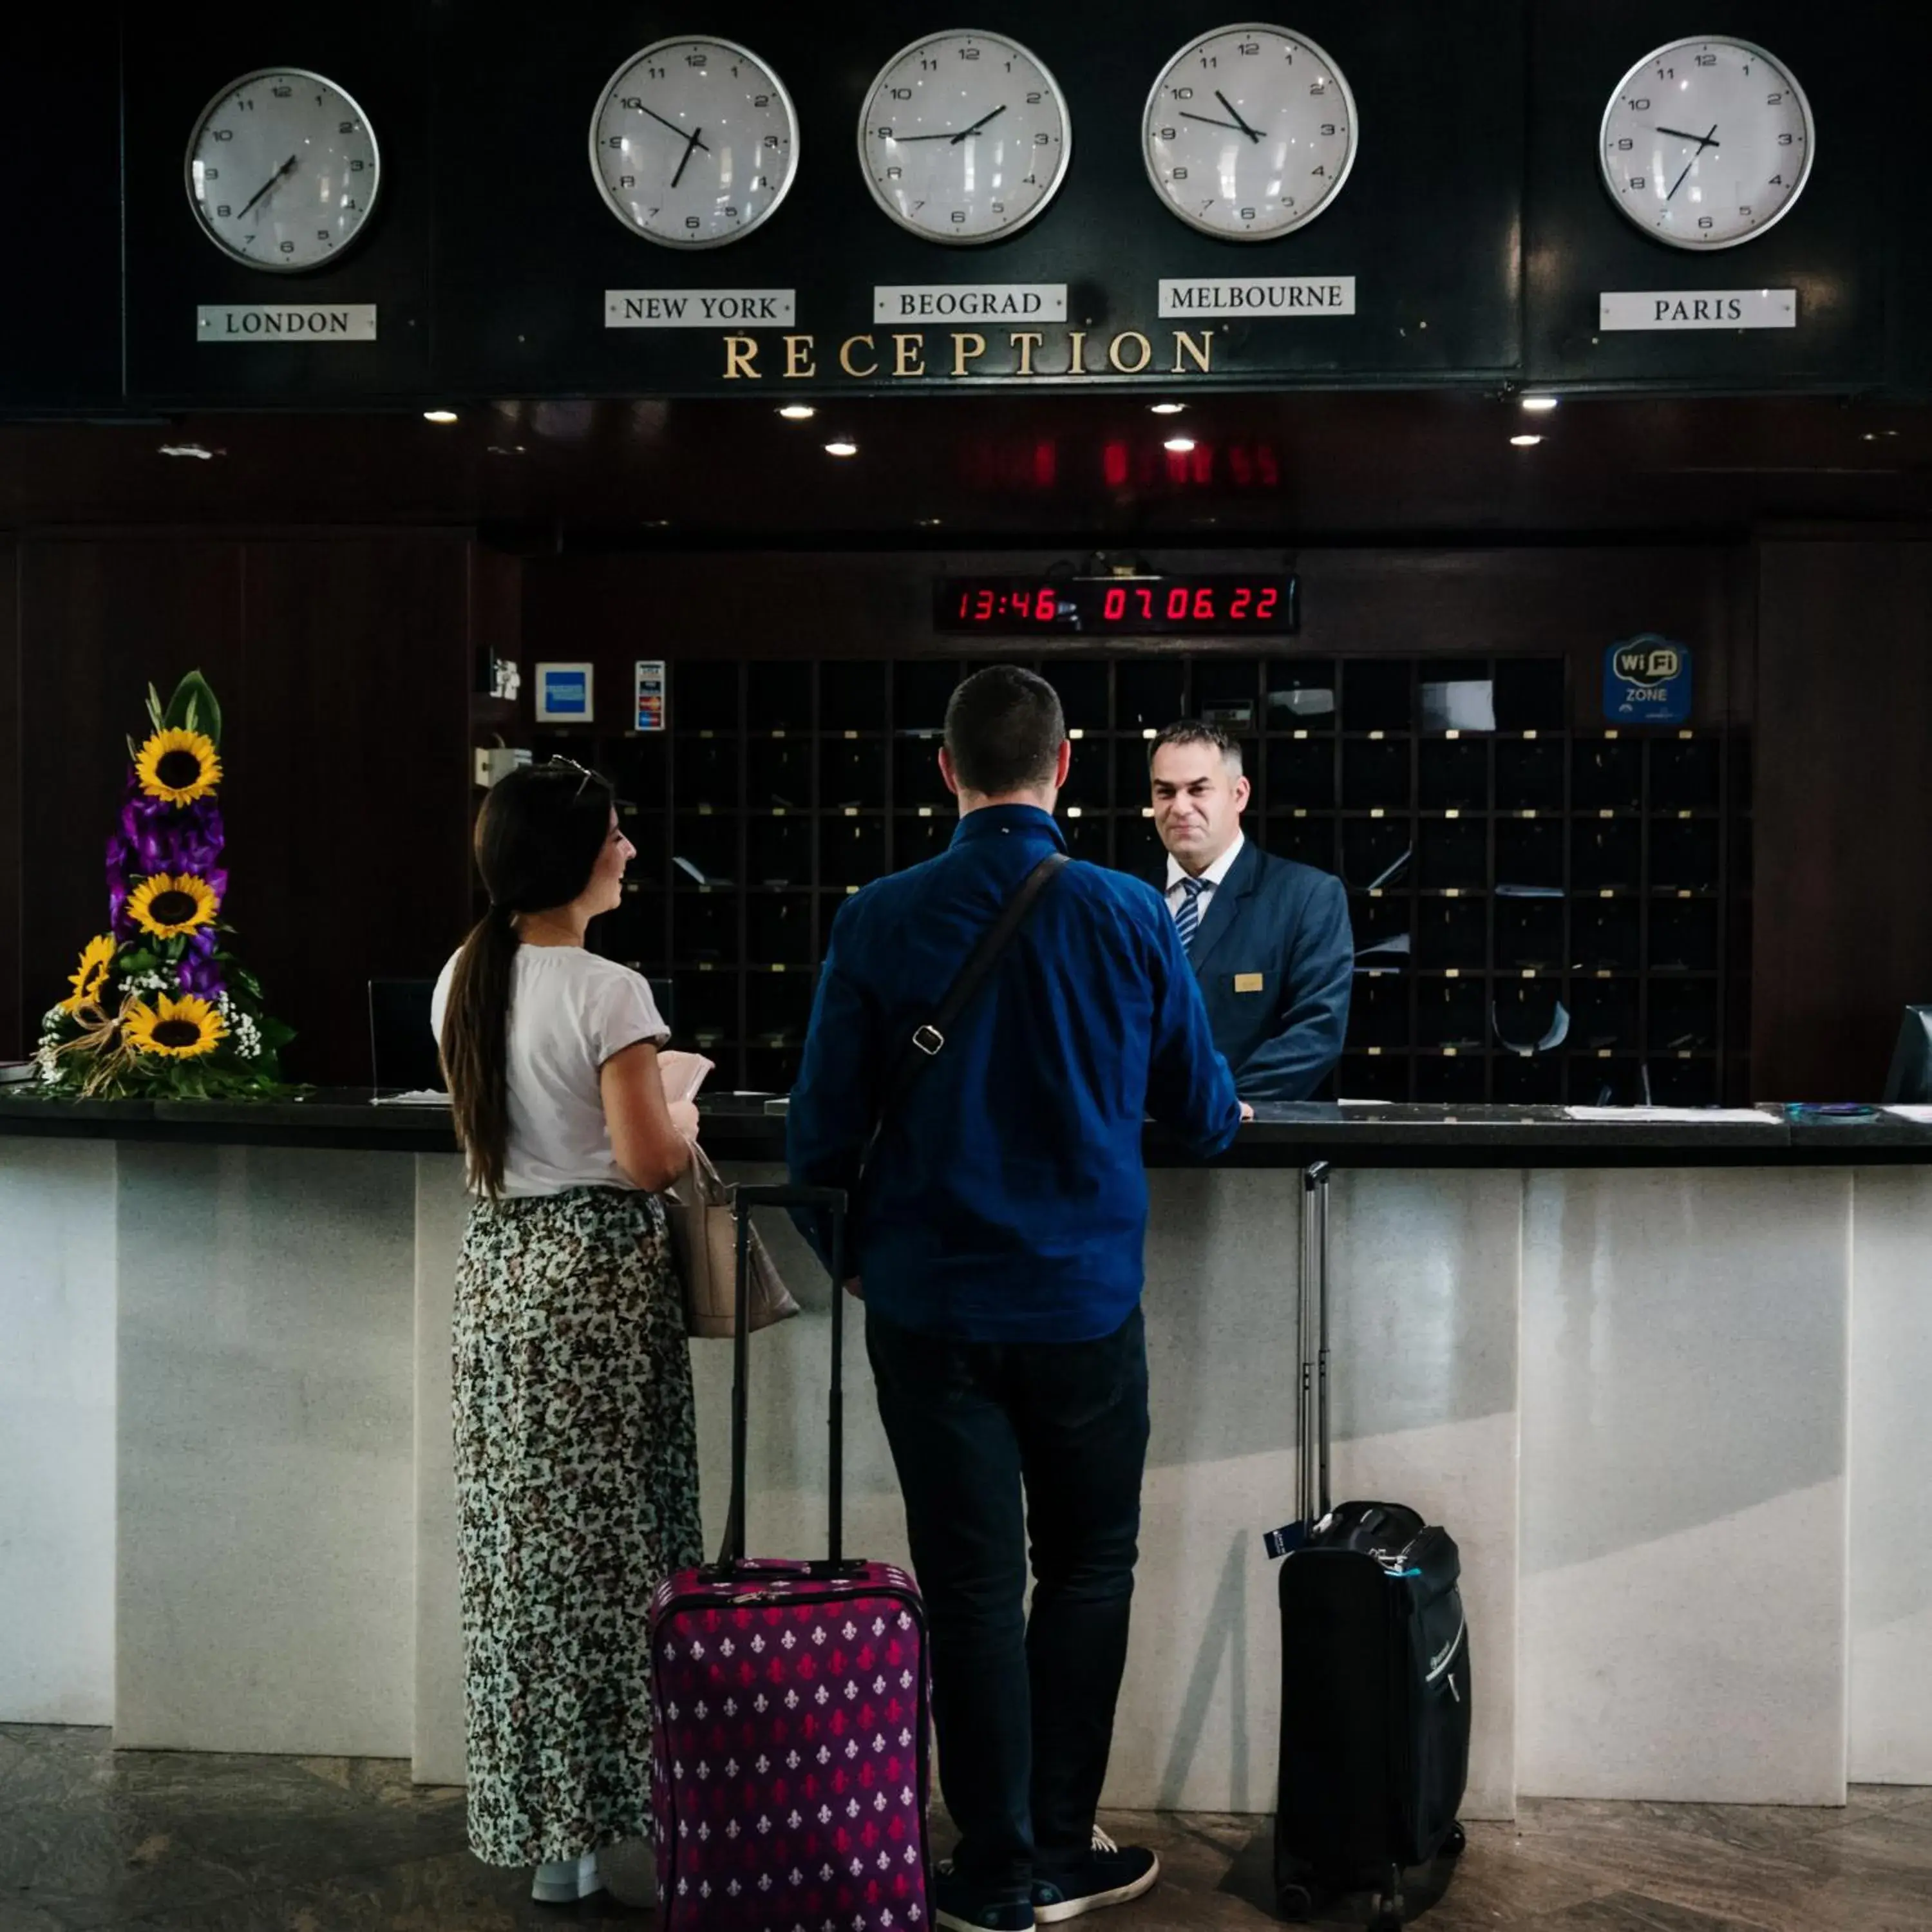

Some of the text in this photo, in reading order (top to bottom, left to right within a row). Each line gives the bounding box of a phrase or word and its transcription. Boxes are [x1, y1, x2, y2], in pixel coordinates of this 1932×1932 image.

[958, 48, 980, 60] 12
[1238, 44, 1259, 55] 12
[685, 55, 706, 66] 12
[921, 60, 937, 71] 11
[1200, 57, 1217, 68] 11
[1285, 55, 1292, 65] 1
[1694, 55, 1716, 66] 12
[731, 67, 738, 78] 1
[1004, 62, 1010, 72] 1
[1743, 65, 1749, 75] 1
[649, 68, 665, 79] 11
[1657, 69, 1674, 80] 11
[272, 86, 292, 98] 12
[890, 88, 912, 100] 10
[1171, 88, 1193, 99] 10
[1310, 83, 1325, 95] 2
[315, 95, 322, 106] 1
[621, 97, 641, 109] 10
[754, 95, 769, 107] 2
[1027, 93, 1041, 104] 2
[1768, 93, 1782, 105] 2
[238, 100, 254, 111] 11
[1628, 99, 1650, 110] 10
[339, 122, 353, 133] 2
[1321, 124, 1335, 136] 3
[213, 131, 232, 142] 10
[878, 128, 893, 139] 9
[1035, 133, 1048, 145] 3
[1161, 128, 1176, 139] 9
[764, 136, 777, 147] 3
[1618, 138, 1633, 150] 9
[1778, 134, 1792, 146] 3
[351, 160, 363, 172] 3
[1311, 166, 1324, 176] 4
[205, 169, 218, 180] 9
[1173, 167, 1188, 179] 8
[620, 176, 634, 187] 8
[1023, 175, 1035, 185] 4
[1630, 177, 1645, 189] 8
[1769, 175, 1781, 185] 4
[914, 201, 925, 210] 7
[992, 203, 1004, 213] 5
[1202, 200, 1214, 209] 7
[217, 206, 231, 217] 8
[1241, 208, 1255, 220] 6
[1739, 206, 1752, 216] 5
[686, 216, 700, 228] 6
[951, 211, 965, 223] 6
[1698, 217, 1712, 229] 6
[245, 235, 256, 244] 7
[317, 231, 328, 240] 5
[280, 242, 294, 253] 6
[1171, 285, 1343, 308] MELBOURNE
[624, 298, 777, 319] NEW YORK
[900, 294, 1041, 315] BEOGRAD
[1654, 299, 1742, 321] PARIS
[226, 313, 349, 332] LONDON
[723, 331, 1213, 379] RECEPTION
[960, 589, 1055, 620] 13:46
[1230, 589, 1277, 618] 22
[1626, 688, 1667, 701] ZONE
